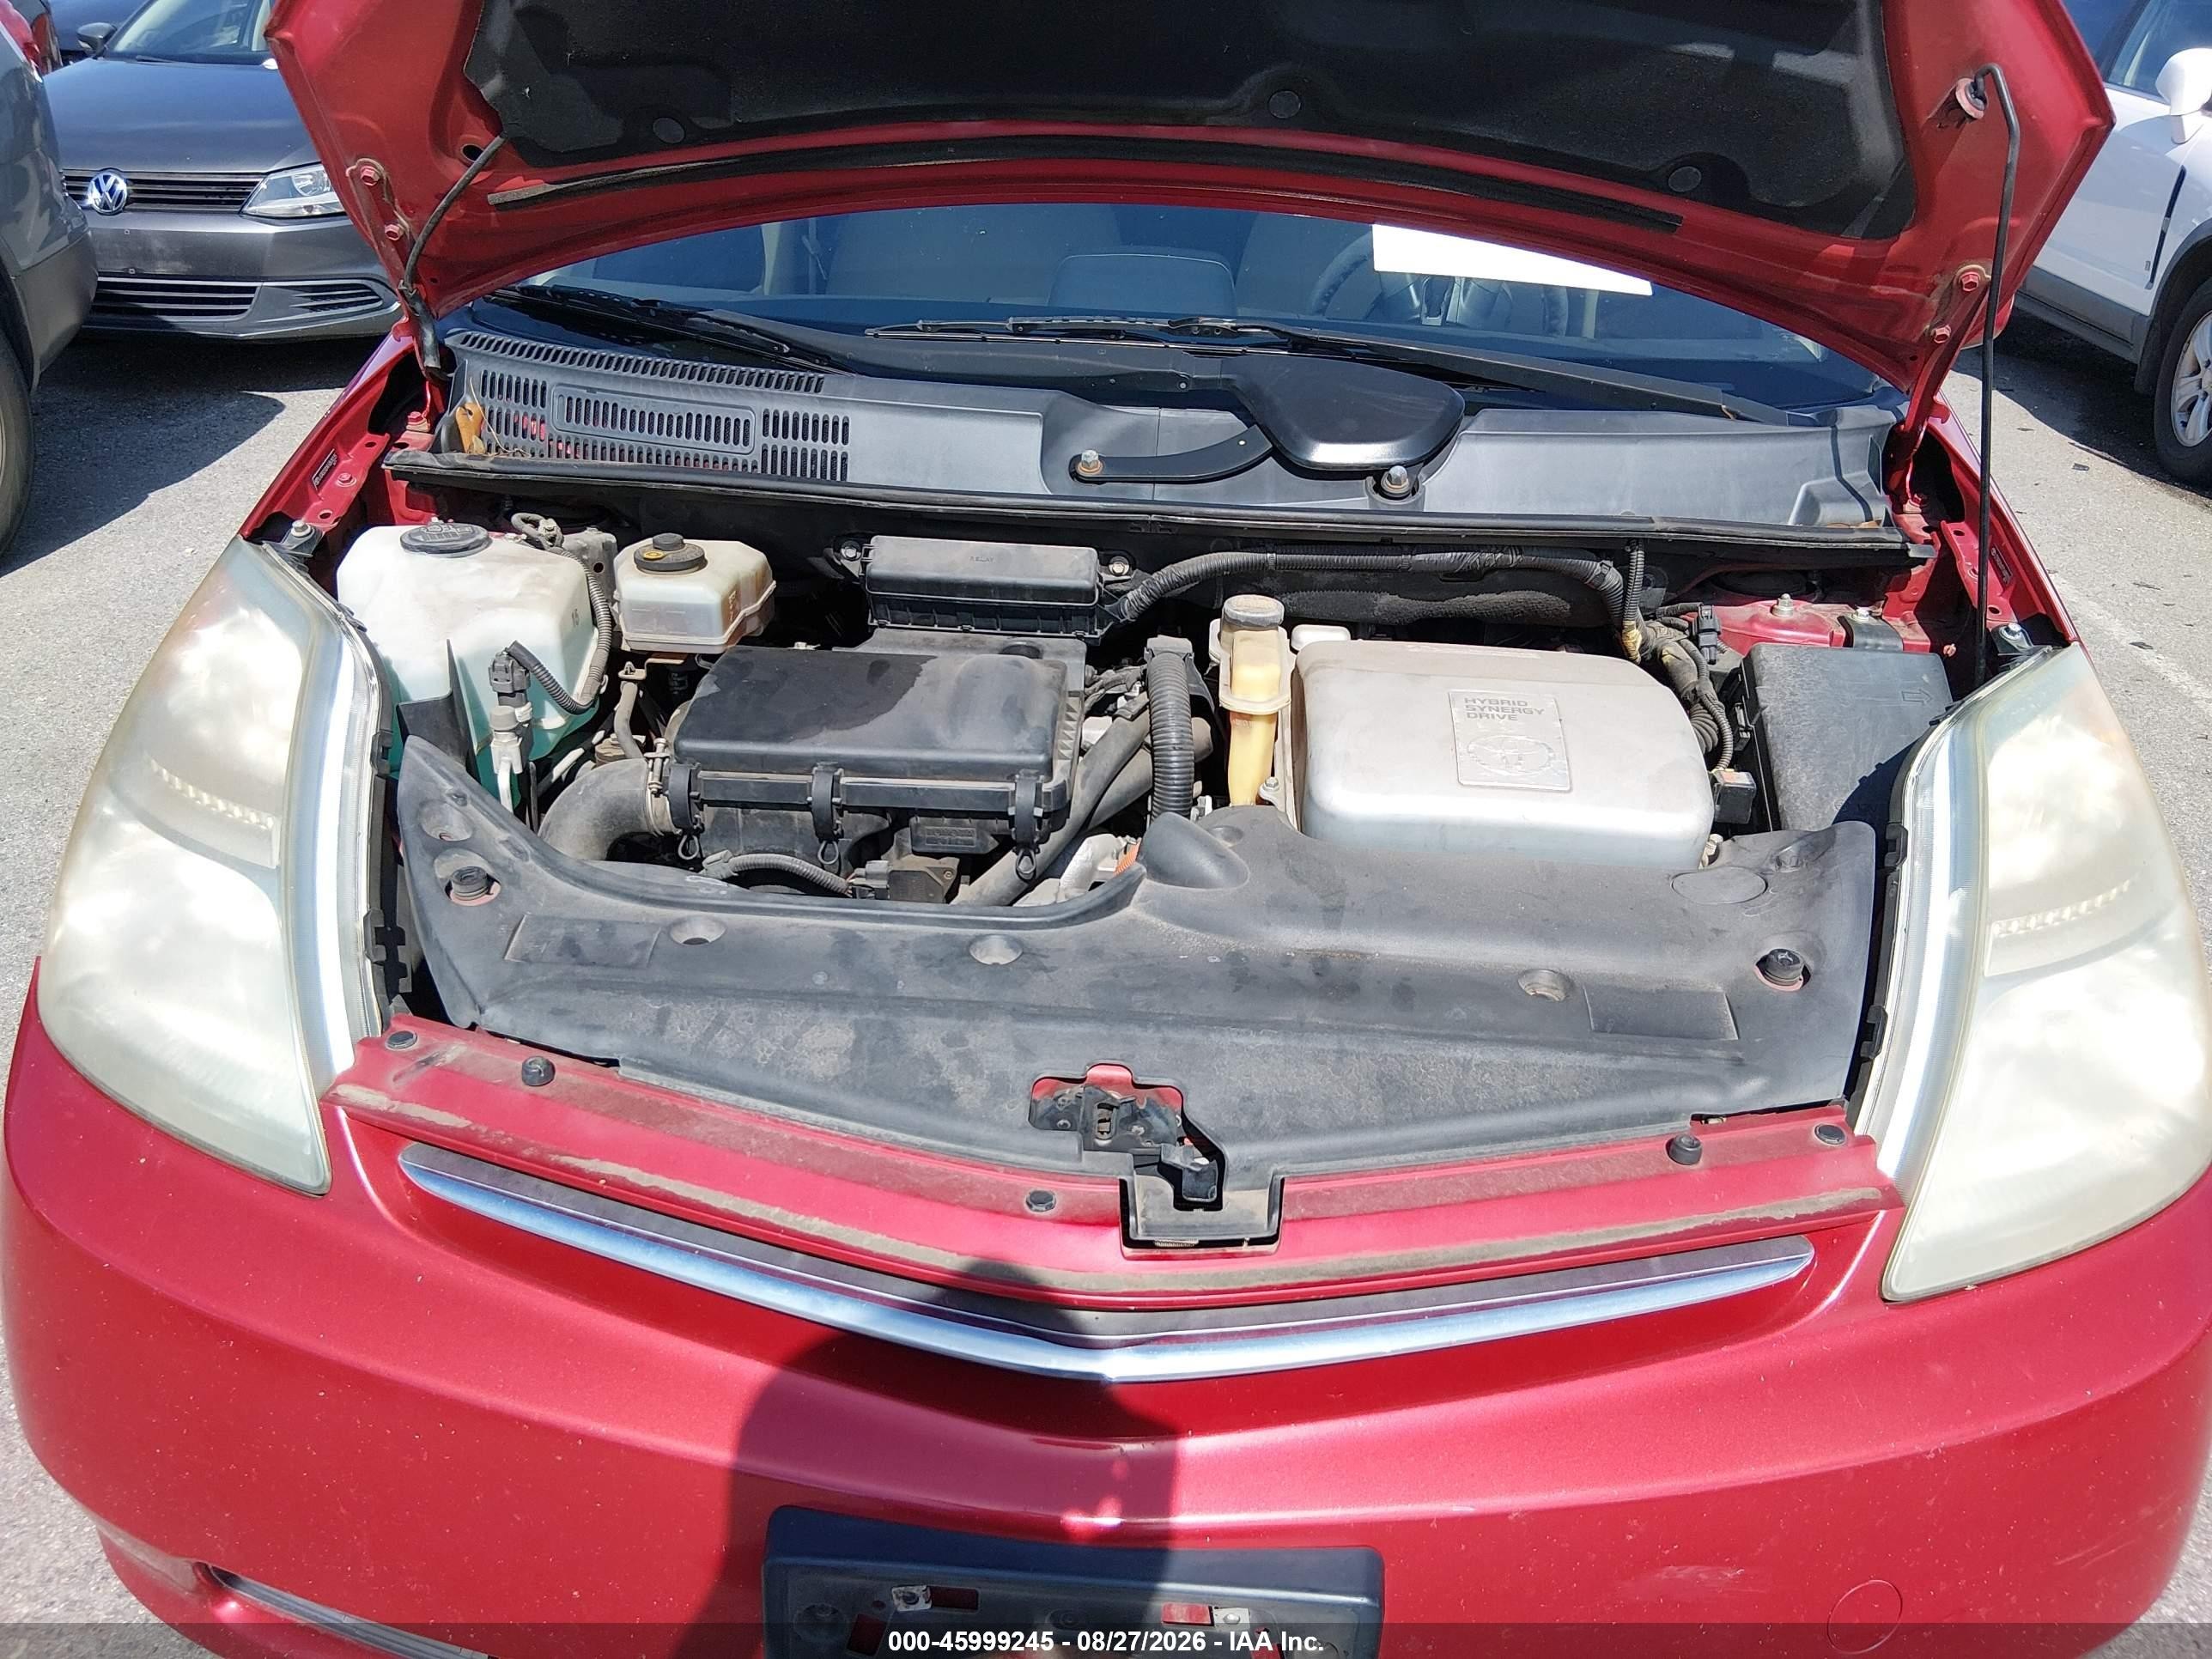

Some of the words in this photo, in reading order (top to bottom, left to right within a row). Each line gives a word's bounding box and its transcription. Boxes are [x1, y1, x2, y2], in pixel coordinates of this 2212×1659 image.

[88, 172, 127, 213] VW
[1463, 697, 1528, 707] HYBRID
[1464, 705, 1545, 715] SYNERGY
[1466, 712, 1519, 721] DRIVE
